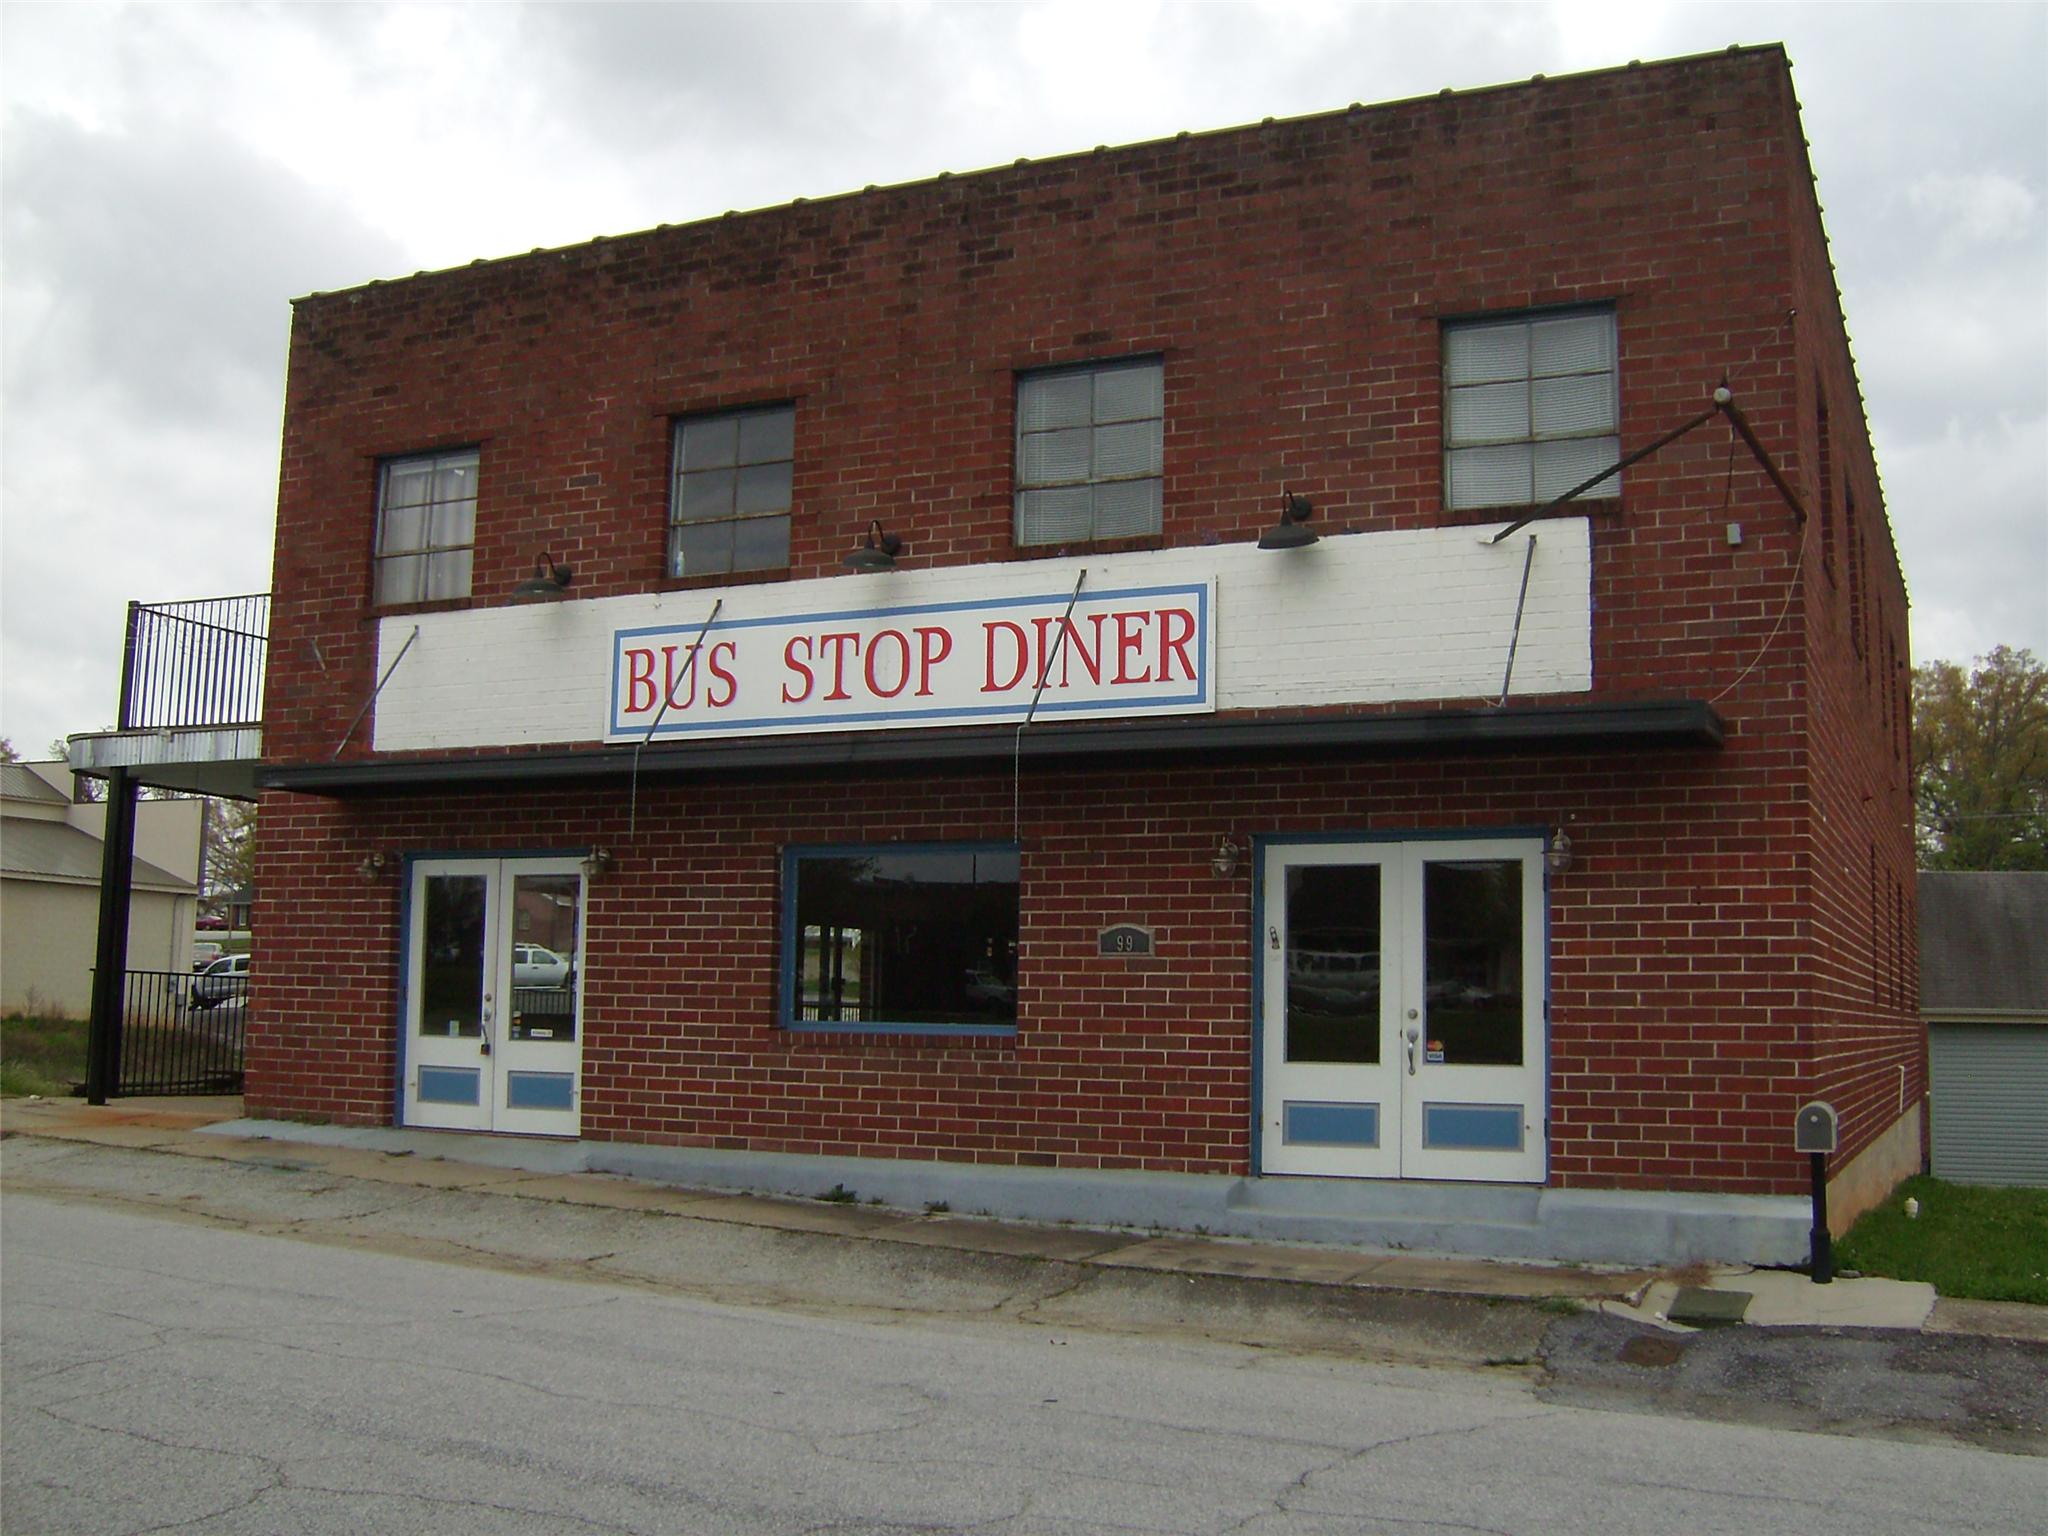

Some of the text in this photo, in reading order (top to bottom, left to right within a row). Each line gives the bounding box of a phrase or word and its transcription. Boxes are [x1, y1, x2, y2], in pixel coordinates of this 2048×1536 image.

[624, 608, 1198, 713] BUS STOP DINER
[1116, 935, 1133, 952] 99
